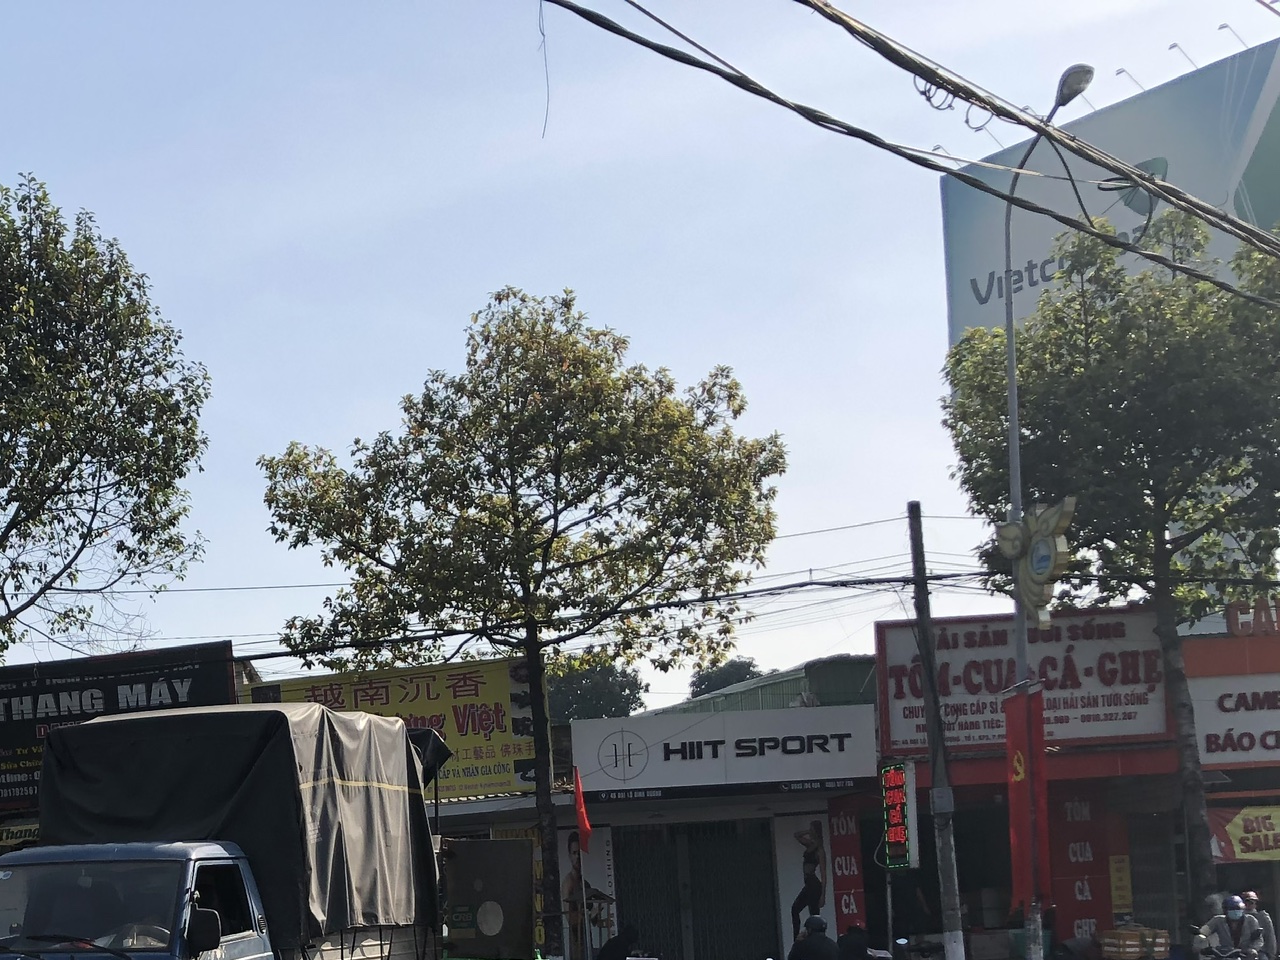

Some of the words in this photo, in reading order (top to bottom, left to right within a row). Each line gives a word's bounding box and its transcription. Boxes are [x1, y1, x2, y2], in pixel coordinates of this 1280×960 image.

[933, 627, 958, 650] ẢI
[1067, 618, 1125, 641] SỐNG
[1039, 644, 1081, 690] CÁ
[1097, 650, 1162, 693] GHẸ
[117, 678, 192, 709] MÁY
[304, 669, 487, 710] 越南沉香
[452, 702, 506, 741] Việt
[663, 740, 725, 761] HIIT
[735, 733, 851, 757] SPORT
[1206, 728, 1256, 752] BÁO
[452, 765, 461, 778] VÀ
[481, 765, 492, 776] GIA
[493, 762, 510, 774] CÔNG
[831, 811, 856, 836] TÔM
[889, 804, 902, 824] CÁ
[1242, 815, 1275, 834] BIG
[1069, 841, 1093, 862] CUA
[1239, 833, 1280, 853] SALE
[835, 856, 858, 876] CUA
[1074, 875, 1092, 900] CÁ
[841, 889, 857, 914] CÁ
